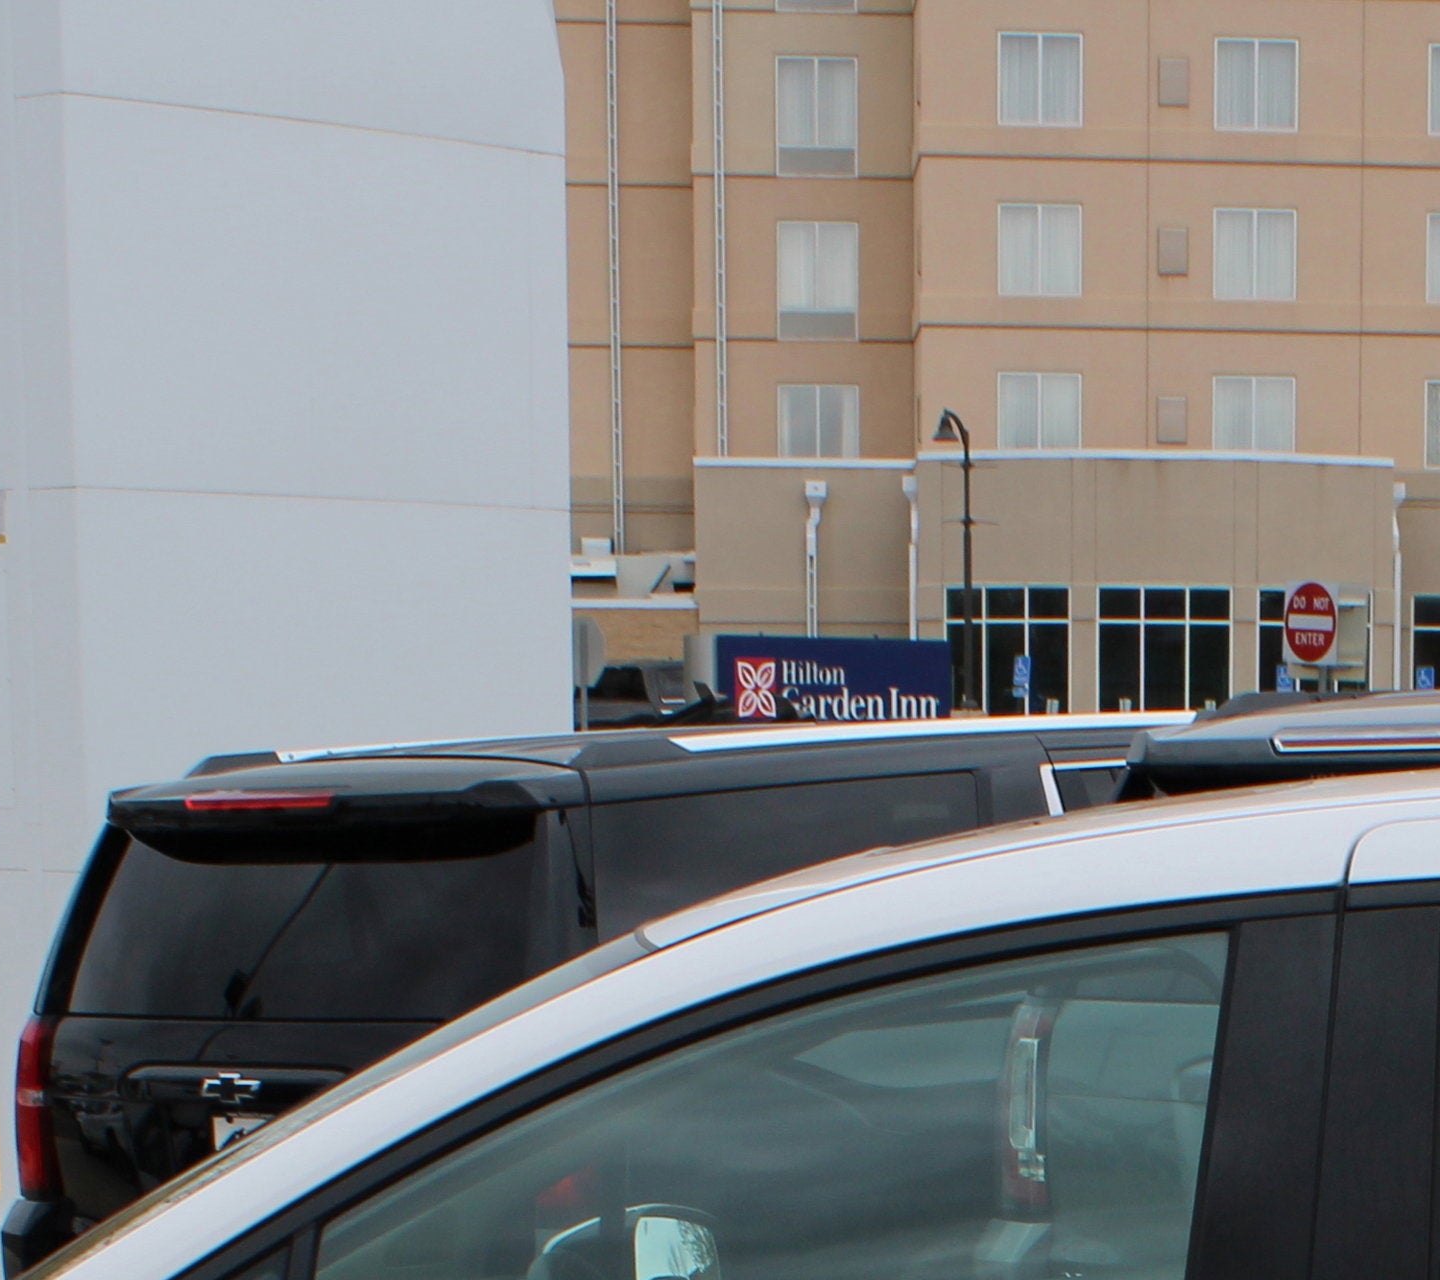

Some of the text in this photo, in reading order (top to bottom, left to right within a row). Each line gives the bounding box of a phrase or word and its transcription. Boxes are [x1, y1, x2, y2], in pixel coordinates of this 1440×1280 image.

[1293, 596, 1329, 611] DO NOT
[1295, 632, 1325, 646] ENTER
[781, 659, 846, 686] Hilton
[888, 687, 939, 720] Inn
